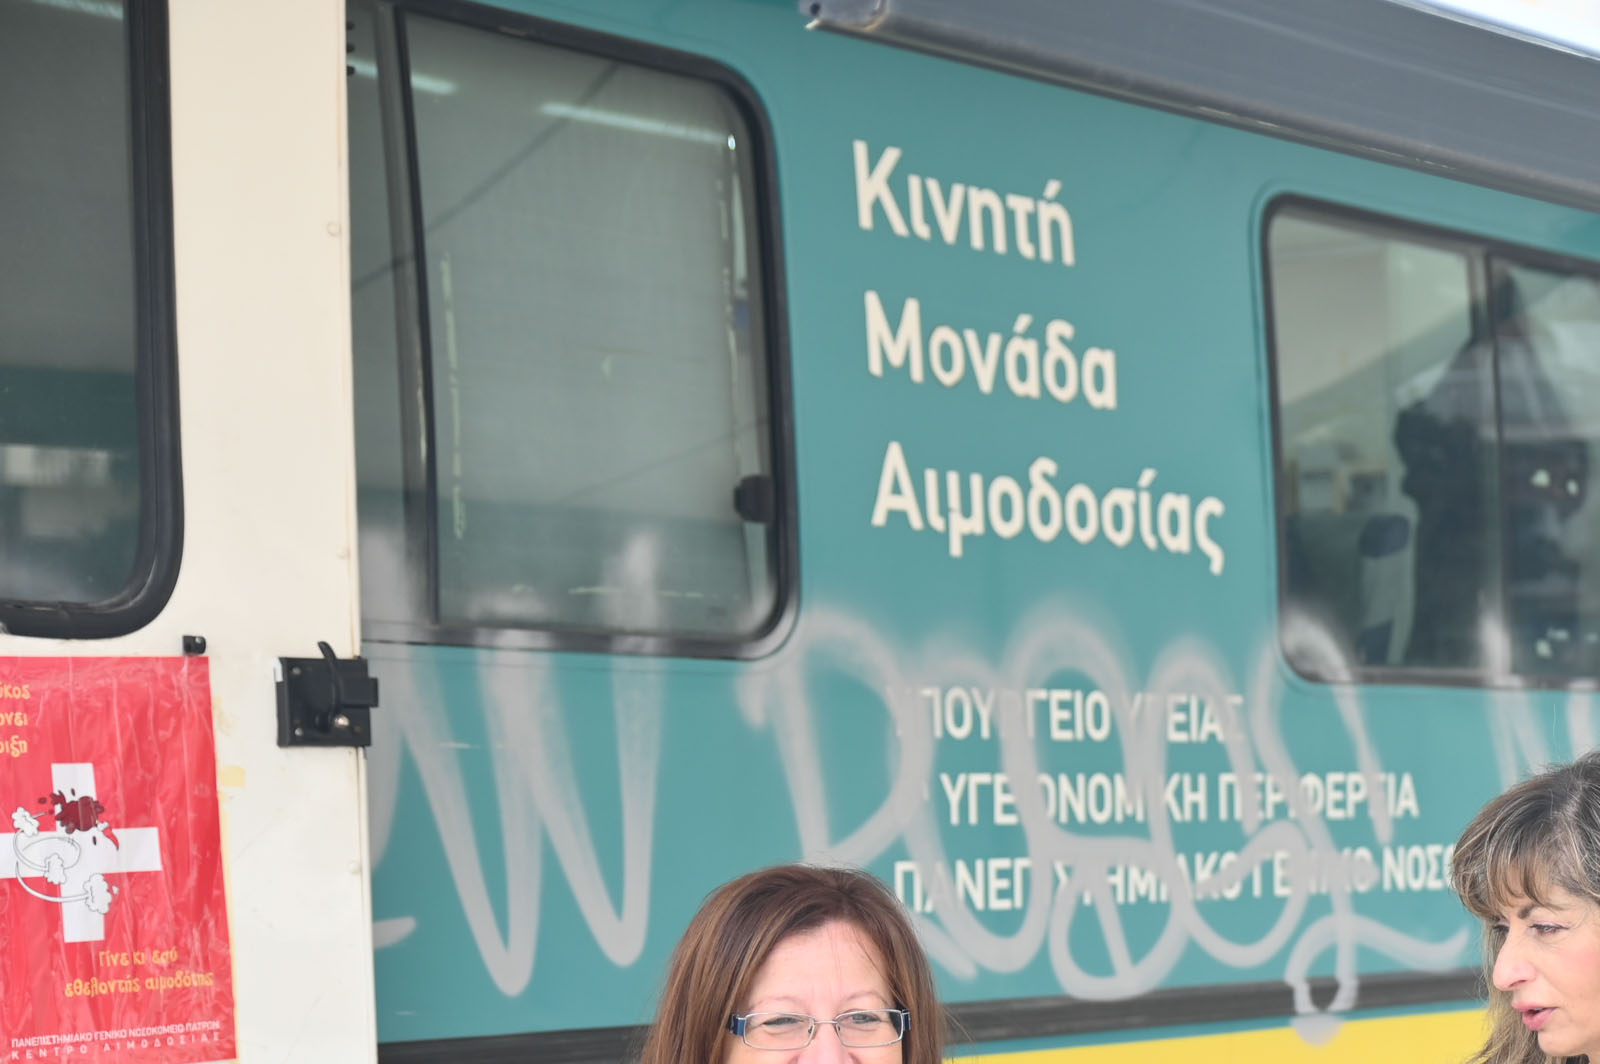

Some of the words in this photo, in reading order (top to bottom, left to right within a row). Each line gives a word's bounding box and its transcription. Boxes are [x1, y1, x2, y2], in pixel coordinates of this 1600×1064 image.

[853, 140, 1075, 267] Κινητή
[864, 290, 1118, 410] Μονάδα
[871, 441, 1225, 576] Αιμοδοσίας
[939, 772, 1208, 826] ΥΓΕΟΝΟΜΚΗ
[64, 974, 141, 998] εθελοντής
[99, 950, 129, 967] Γίνε
